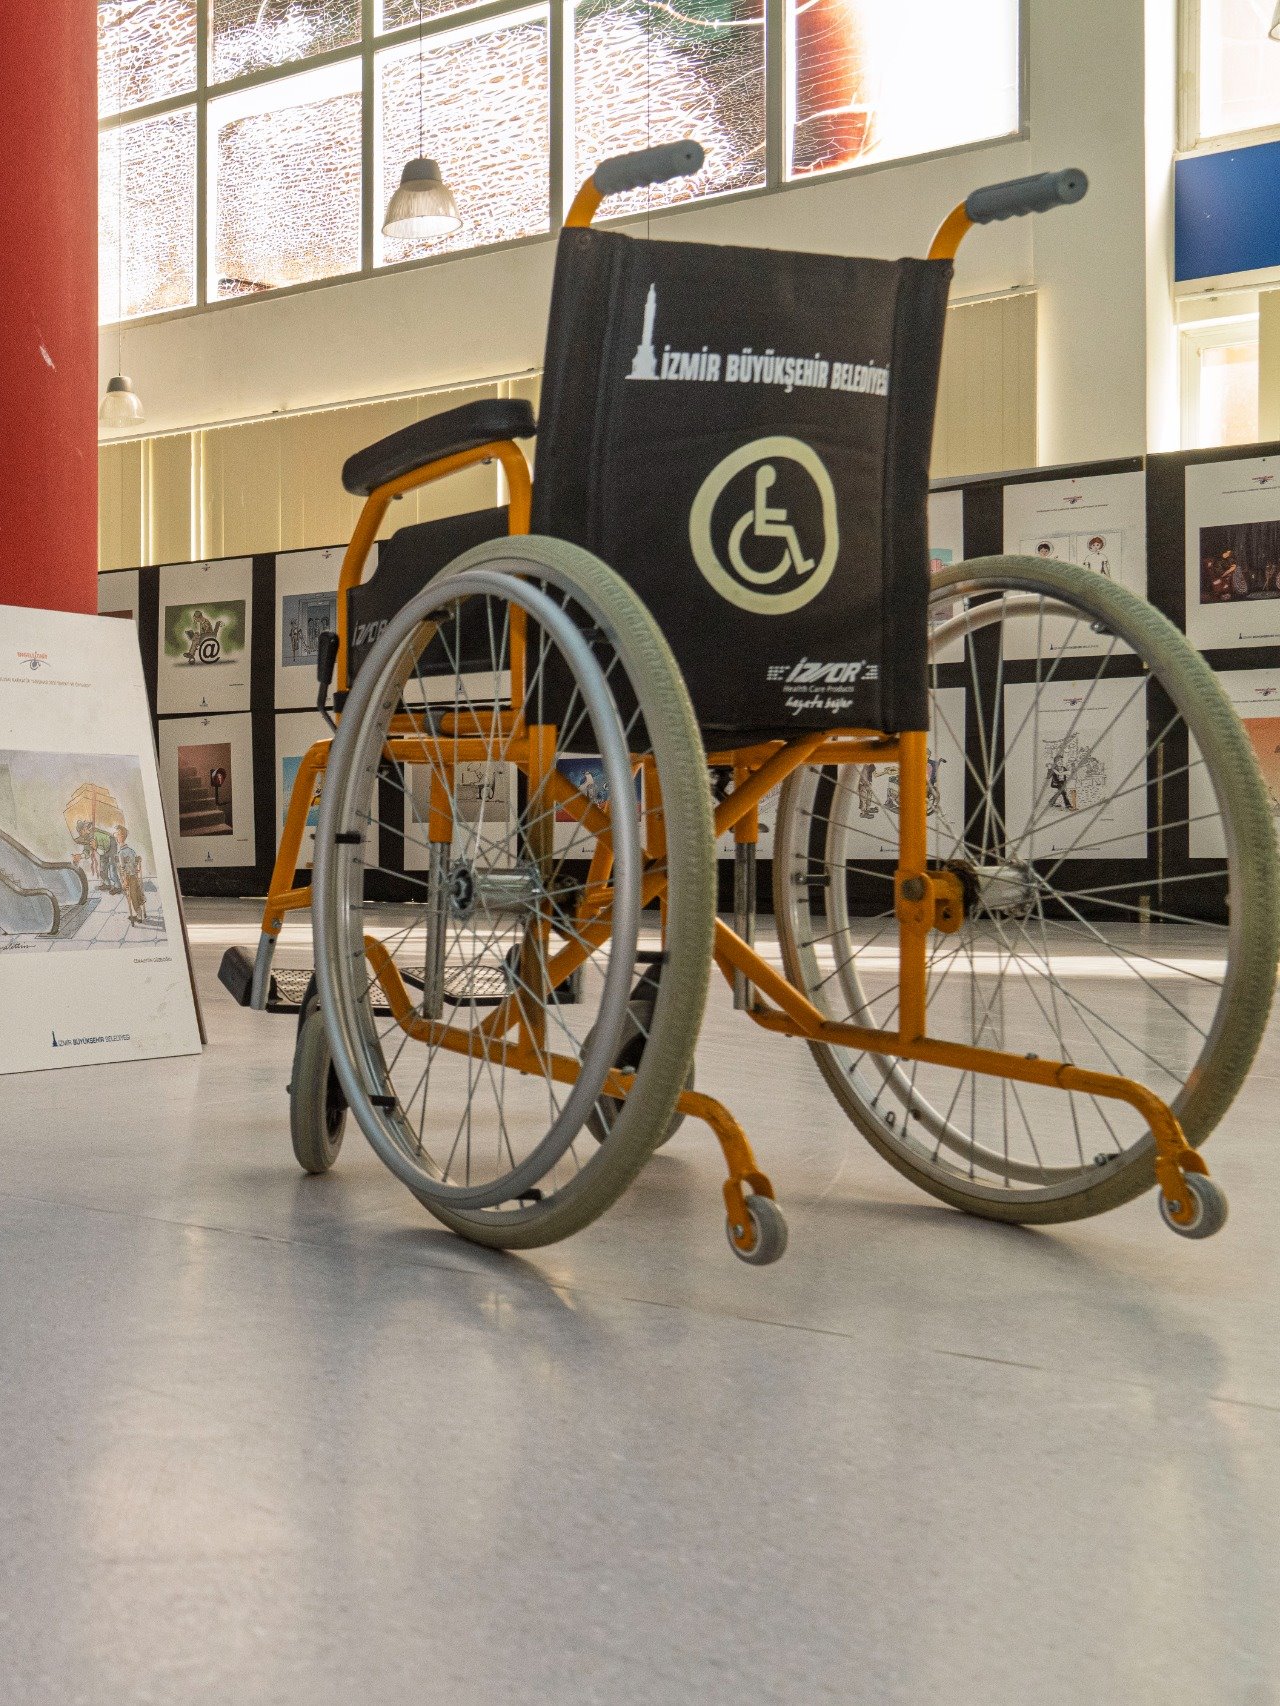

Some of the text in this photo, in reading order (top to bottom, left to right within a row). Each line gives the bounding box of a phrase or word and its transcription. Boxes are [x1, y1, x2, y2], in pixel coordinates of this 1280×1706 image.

[660, 344, 721, 382] İZMİR
[725, 347, 829, 394] BÜYÜKŞEHİR
[809, 685, 826, 693] Care
